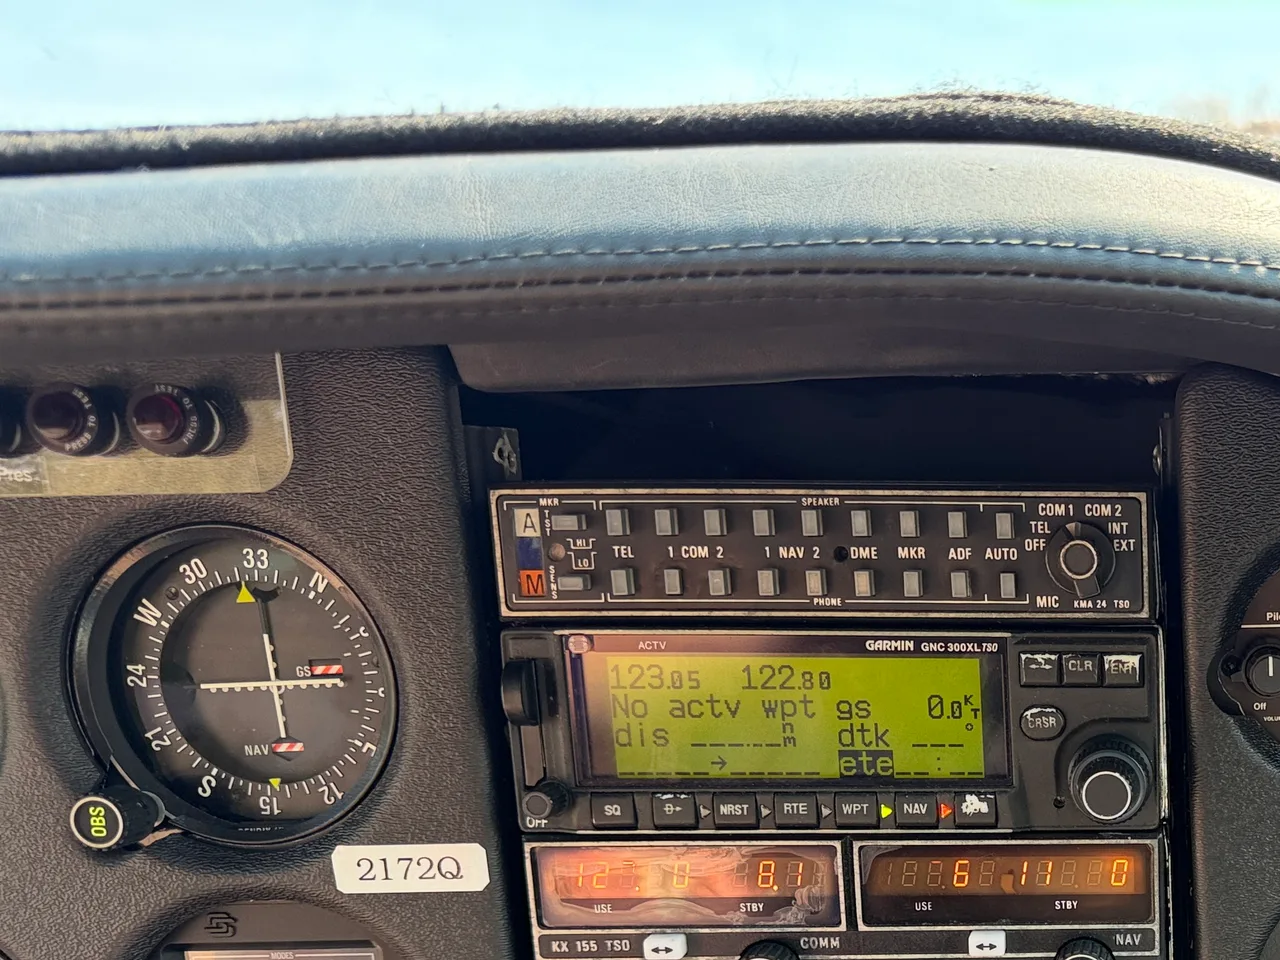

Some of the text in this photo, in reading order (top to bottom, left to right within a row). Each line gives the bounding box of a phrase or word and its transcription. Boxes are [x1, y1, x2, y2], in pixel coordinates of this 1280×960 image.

[539, 498, 559, 507] MKR
[801, 497, 840, 507] SPEAKER
[1108, 523, 1128, 534] INT
[1114, 540, 1135, 552] EXT
[243, 548, 268, 568] 33
[850, 548, 877, 559] DME
[985, 548, 1017, 560] AUTO
[813, 598, 842, 607] PHONE
[1037, 596, 1059, 608] MIC
[1074, 601, 1093, 609] KMA
[638, 641, 666, 649] ACTV
[866, 640, 914, 650] GARMIN
[611, 664, 701, 690] 123.05
[742, 665, 831, 690] 122.80
[612, 694, 815, 721] No actv wpt
[837, 701, 871, 719] gs
[616, 723, 669, 747] dis
[839, 723, 890, 747] dtk
[840, 751, 893, 774] ete
[720, 804, 748, 815] NRST
[842, 804, 868, 815] WPT
[90, 806, 106, 837] OBS
[357, 856, 463, 880] 2172Q
[740, 903, 764, 912] STBY
[552, 941, 629, 952] KX 155 TSO
[801, 938, 840, 949] COMM
